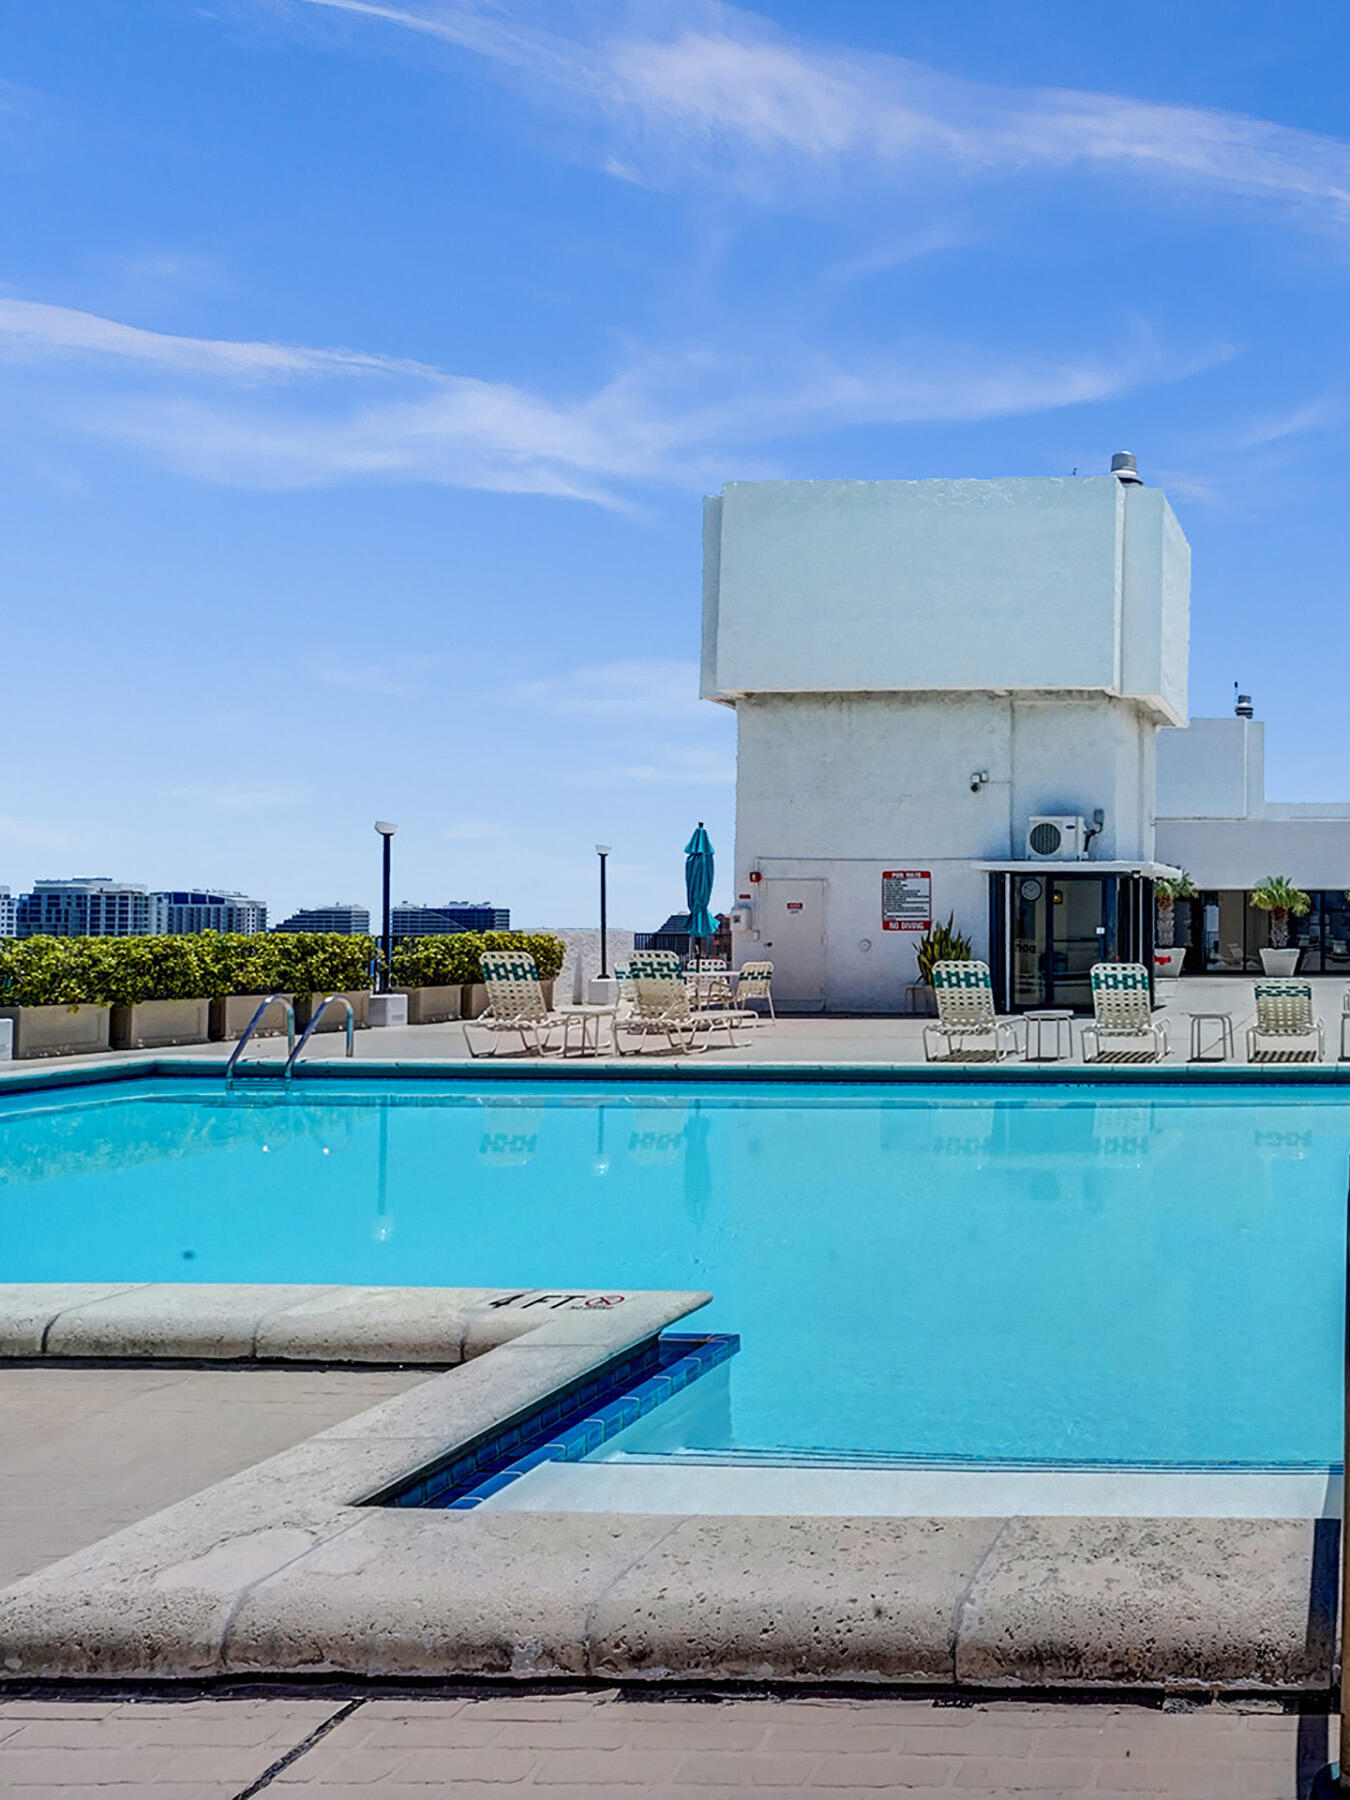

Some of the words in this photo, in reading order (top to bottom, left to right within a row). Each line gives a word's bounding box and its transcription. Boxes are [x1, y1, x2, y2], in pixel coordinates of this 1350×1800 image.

[889, 922, 899, 930] NO
[901, 922, 924, 930] DIVING
[489, 1294, 525, 1309] 4
[521, 1295, 587, 1309] FT
